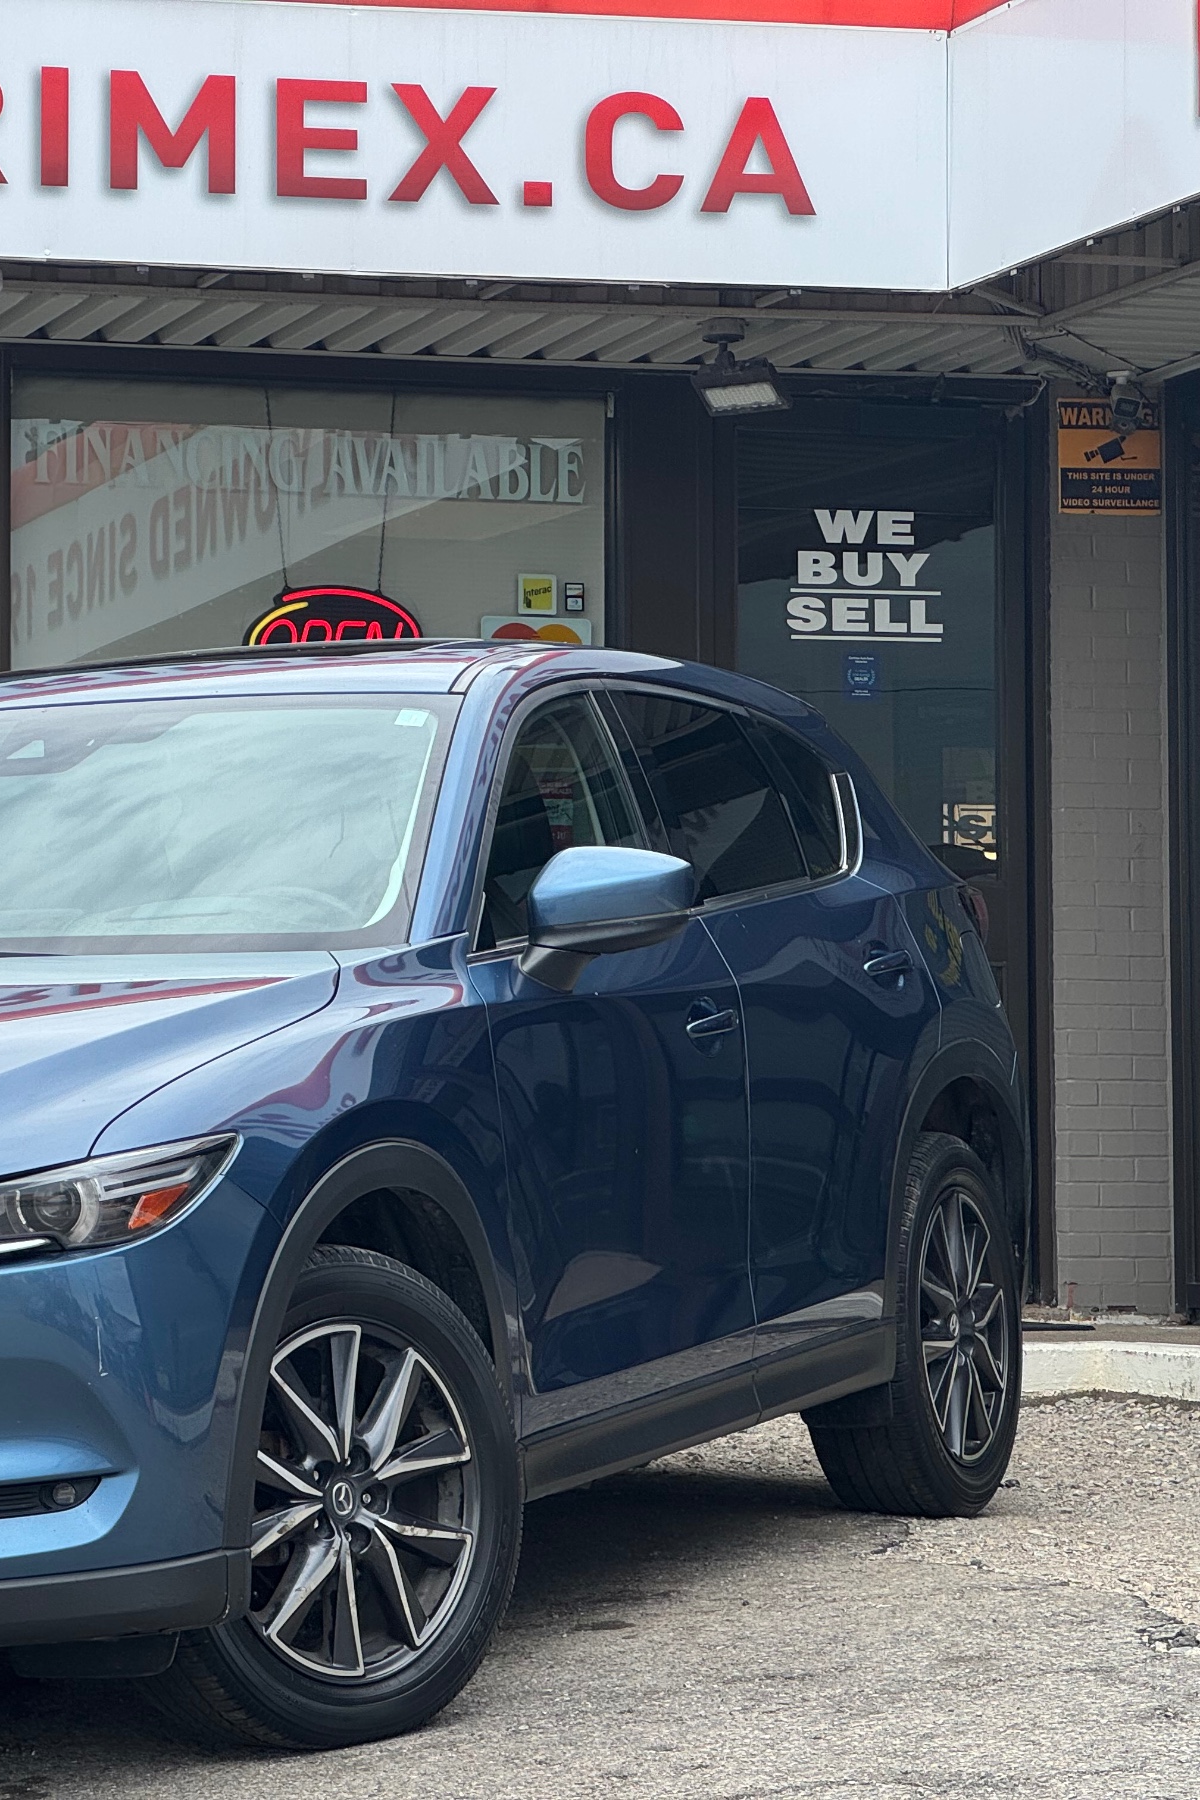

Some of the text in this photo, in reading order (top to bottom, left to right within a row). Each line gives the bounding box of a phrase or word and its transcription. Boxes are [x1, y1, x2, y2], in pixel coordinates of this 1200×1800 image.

[33, 424, 306, 494] FINANCING
[322, 431, 586, 504] AVAILABLE
[1067, 472, 1088, 480] THIS
[1090, 472, 1111, 480] SITE
[1112, 472, 1121, 480] IS
[1091, 485, 1131, 494] 24 HOUR
[1062, 498, 1160, 507] VIDEO SURVEILLANCE
[814, 508, 916, 545] WE
[797, 550, 931, 587] BUY
[523, 586, 552, 599] Interac
[786, 597, 944, 634] SELL
